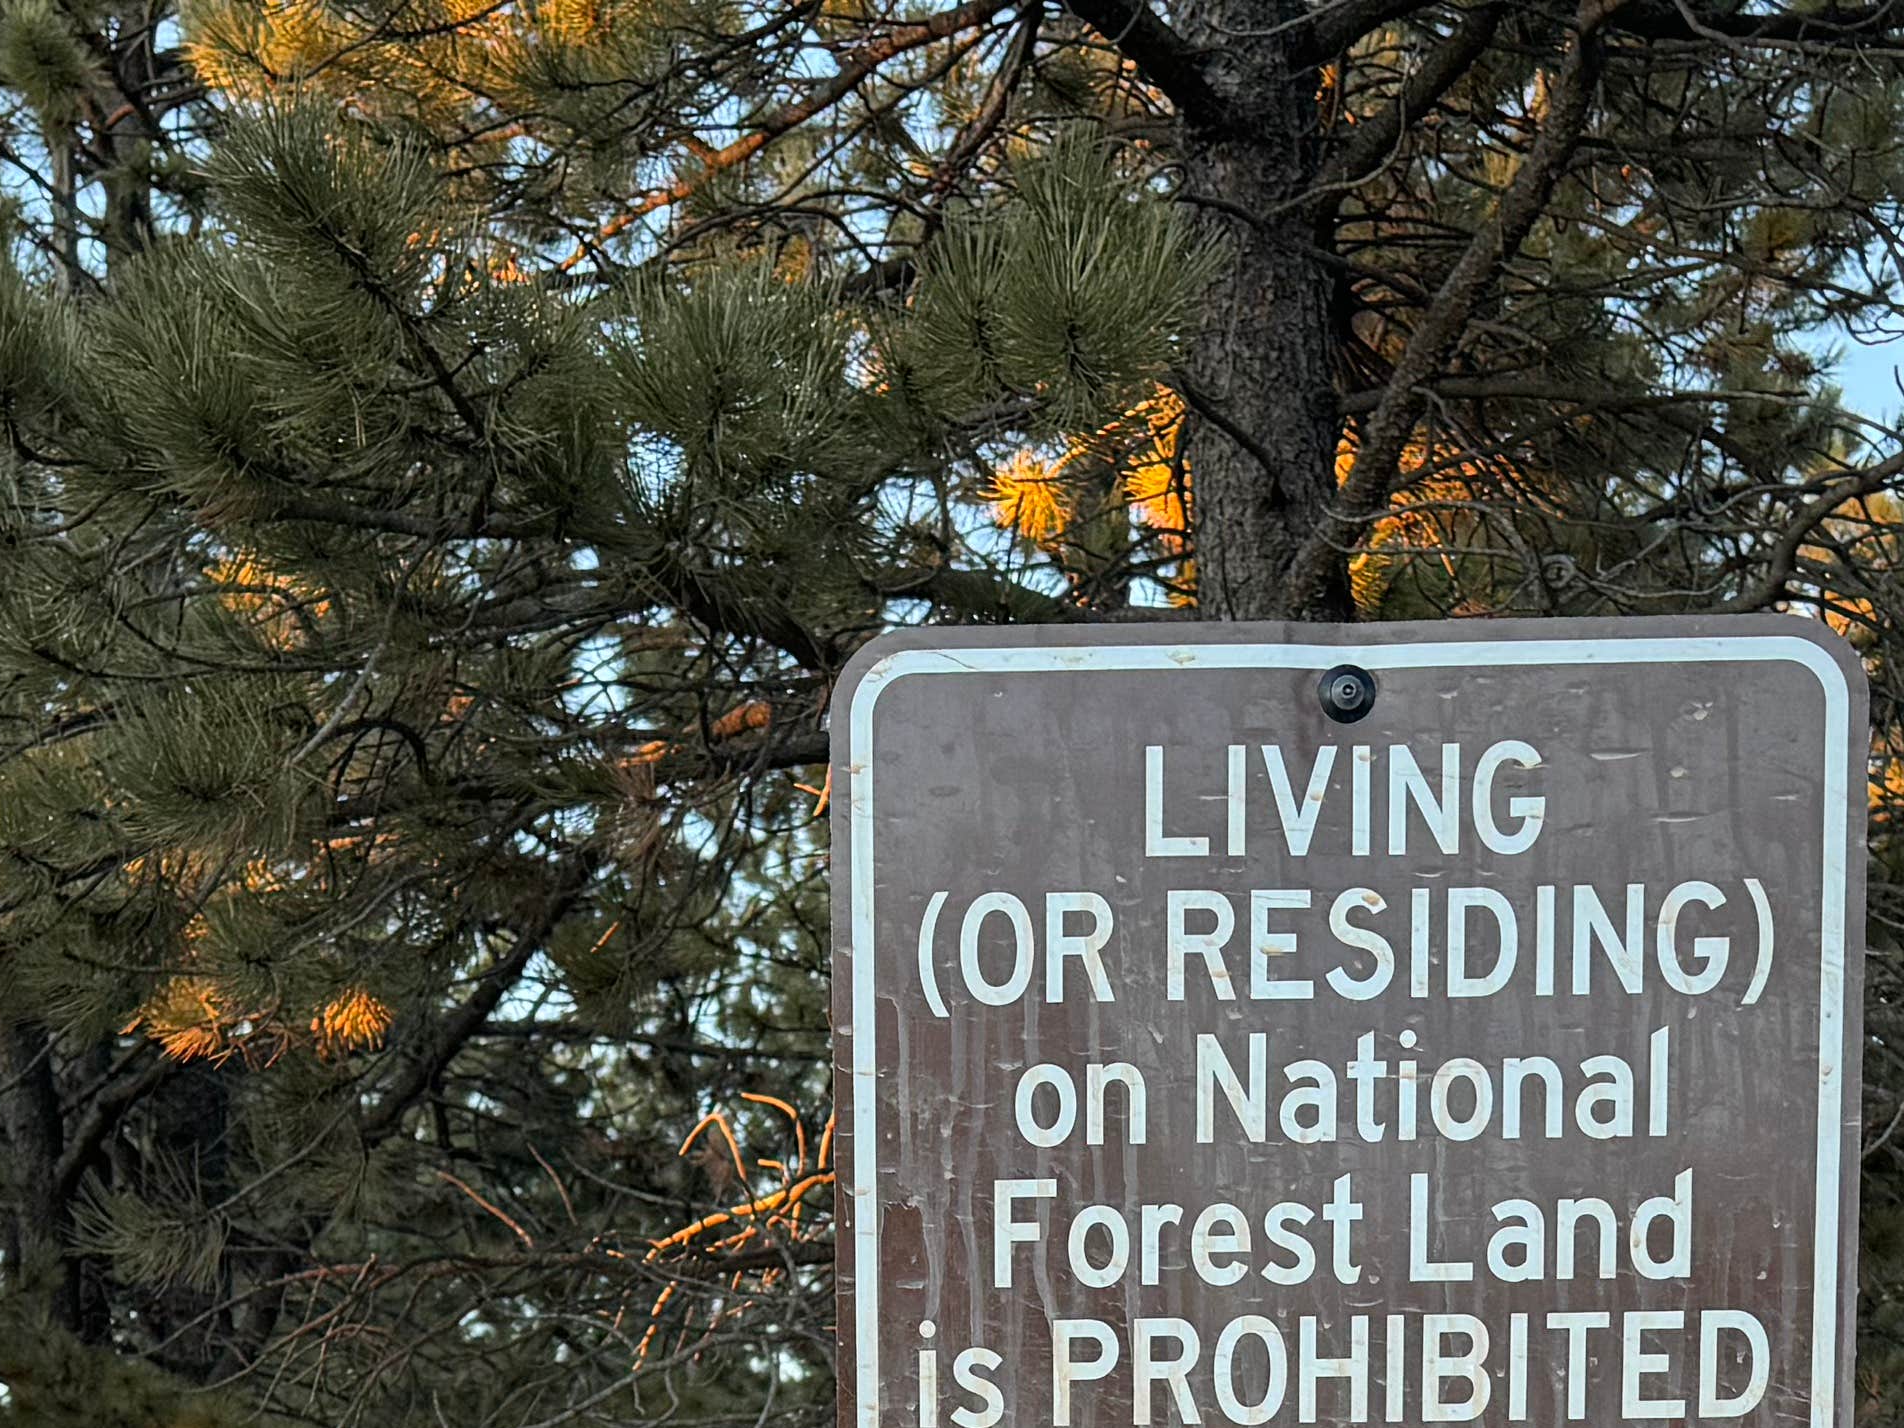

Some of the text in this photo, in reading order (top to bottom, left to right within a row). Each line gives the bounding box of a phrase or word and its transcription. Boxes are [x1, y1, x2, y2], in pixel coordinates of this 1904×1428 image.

[1145, 740, 1545, 857] LIVING
[918, 877, 1775, 1018] (OR RESIDING)
[1015, 1025, 1669, 1147] on National
[994, 1168, 1692, 1288] Forest Land
[1052, 1310, 1769, 1427] PROHIBITED
